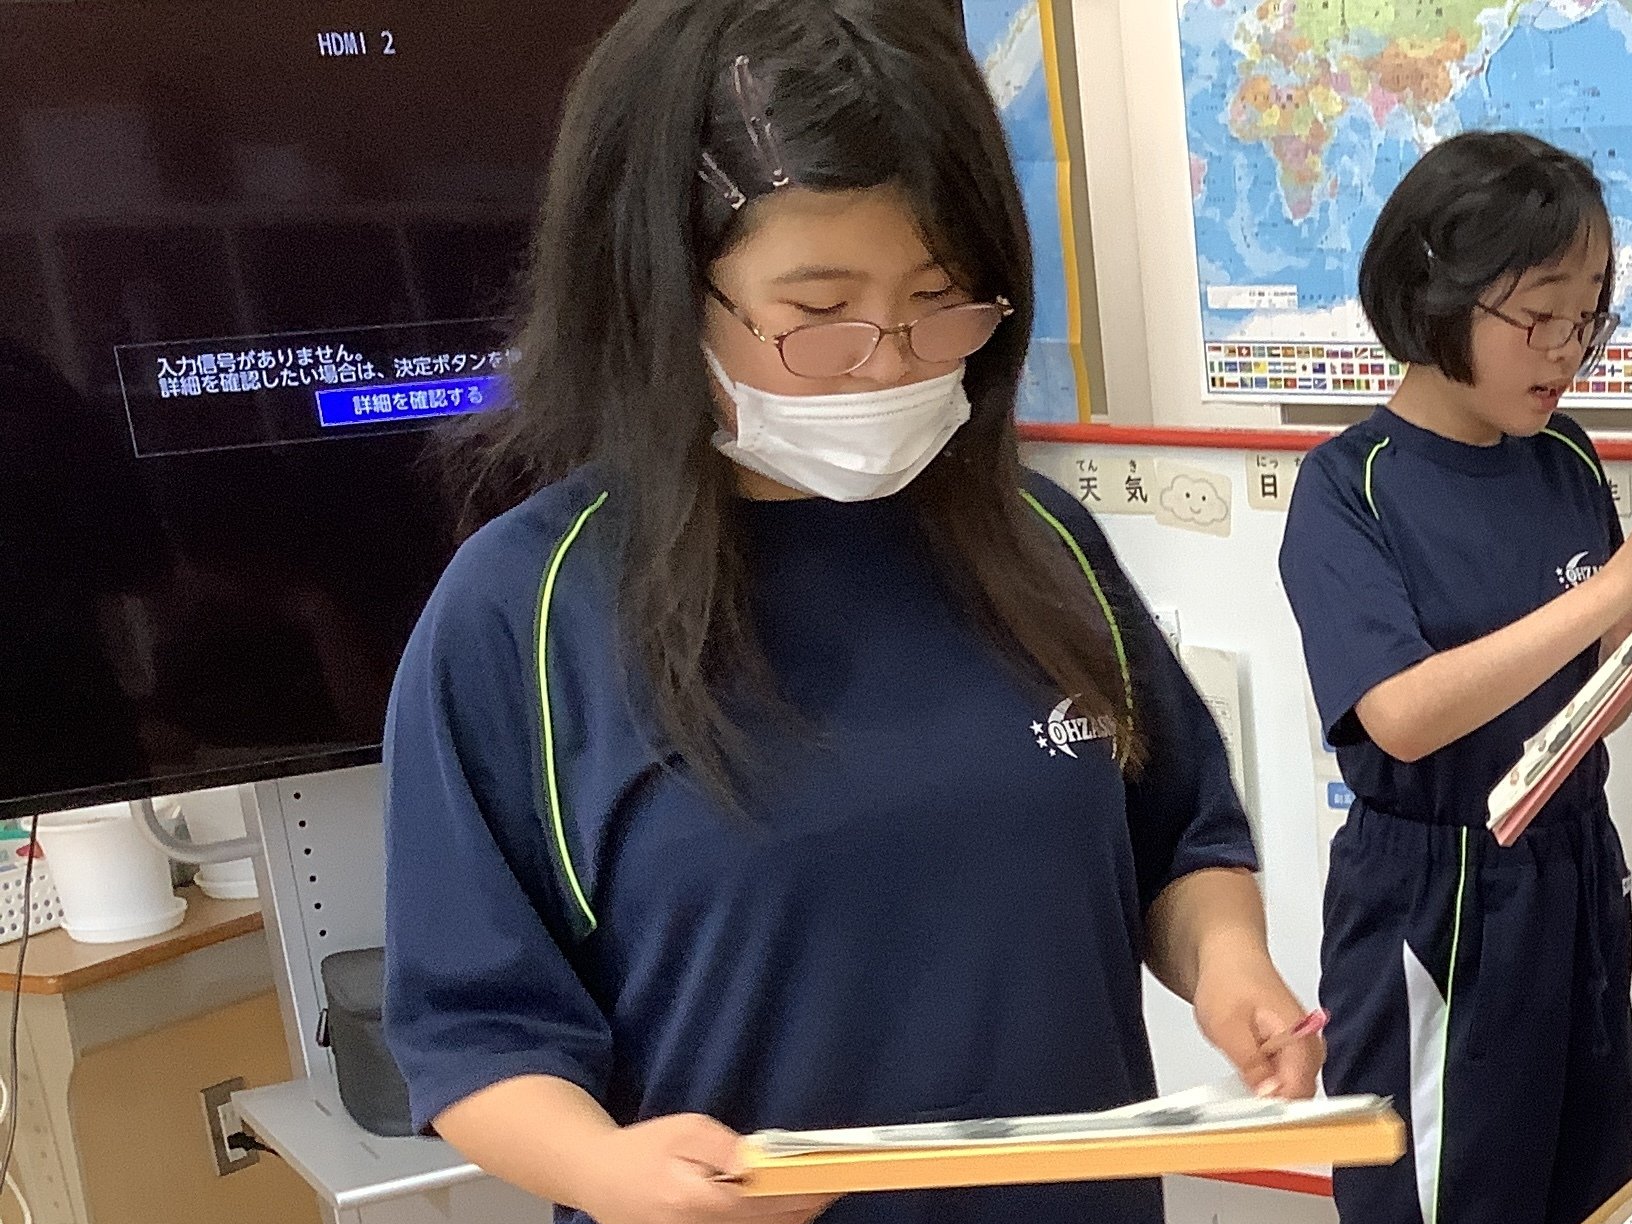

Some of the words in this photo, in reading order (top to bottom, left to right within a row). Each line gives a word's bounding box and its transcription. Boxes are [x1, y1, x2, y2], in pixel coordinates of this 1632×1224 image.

[317, 31, 366, 56] HDMI
[380, 30, 396, 54] 2
[157, 344, 364, 378] 入力信号がありません。
[351, 386, 484, 415] 詳細を確認する
